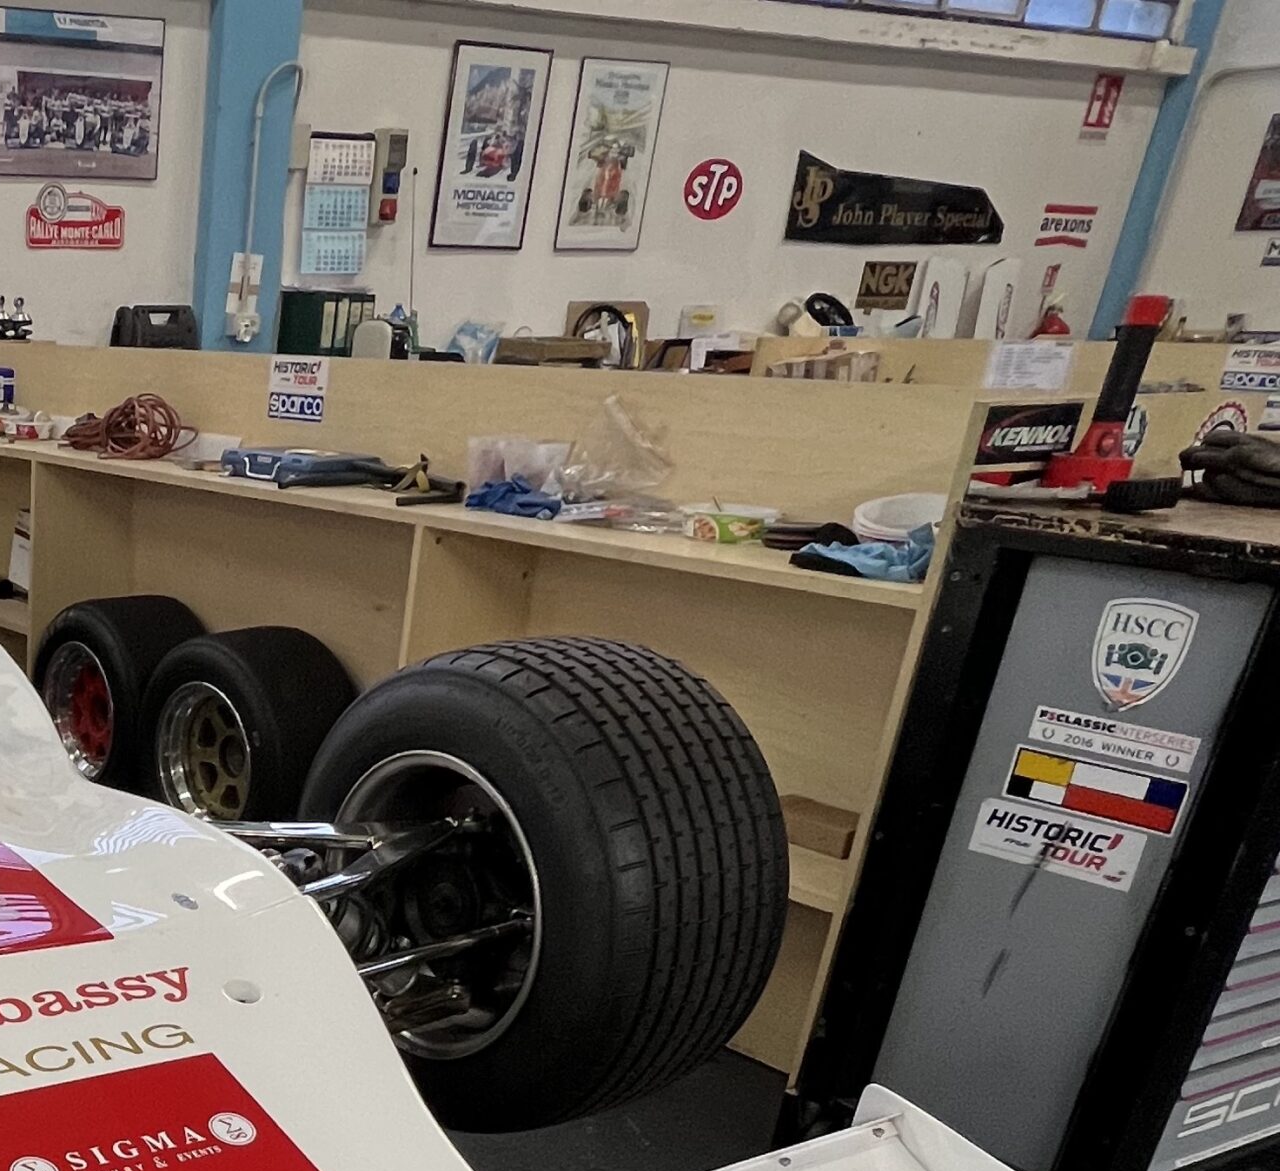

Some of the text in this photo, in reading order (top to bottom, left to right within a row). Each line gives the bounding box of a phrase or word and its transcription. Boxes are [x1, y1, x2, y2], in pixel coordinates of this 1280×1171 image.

[453, 189, 516, 203] MONACO
[687, 163, 738, 211] STP
[832, 203, 993, 230] John Player Special
[1040, 216, 1093, 234] arexons
[860, 264, 916, 297] NGK
[294, 374, 318, 386] TOUR
[270, 394, 323, 415] sparco
[986, 424, 1073, 448] KENNOL
[1111, 611, 1185, 642] HSCC
[1064, 733, 1155, 761] 2016 WINNER
[1041, 841, 1108, 871] TOUR
[1176, 1077, 1280, 1138] SC
[65, 1126, 206, 1171] SIGMA
[153, 1156, 168, 1170] &
[176, 1145, 223, 1163] EVENTS
